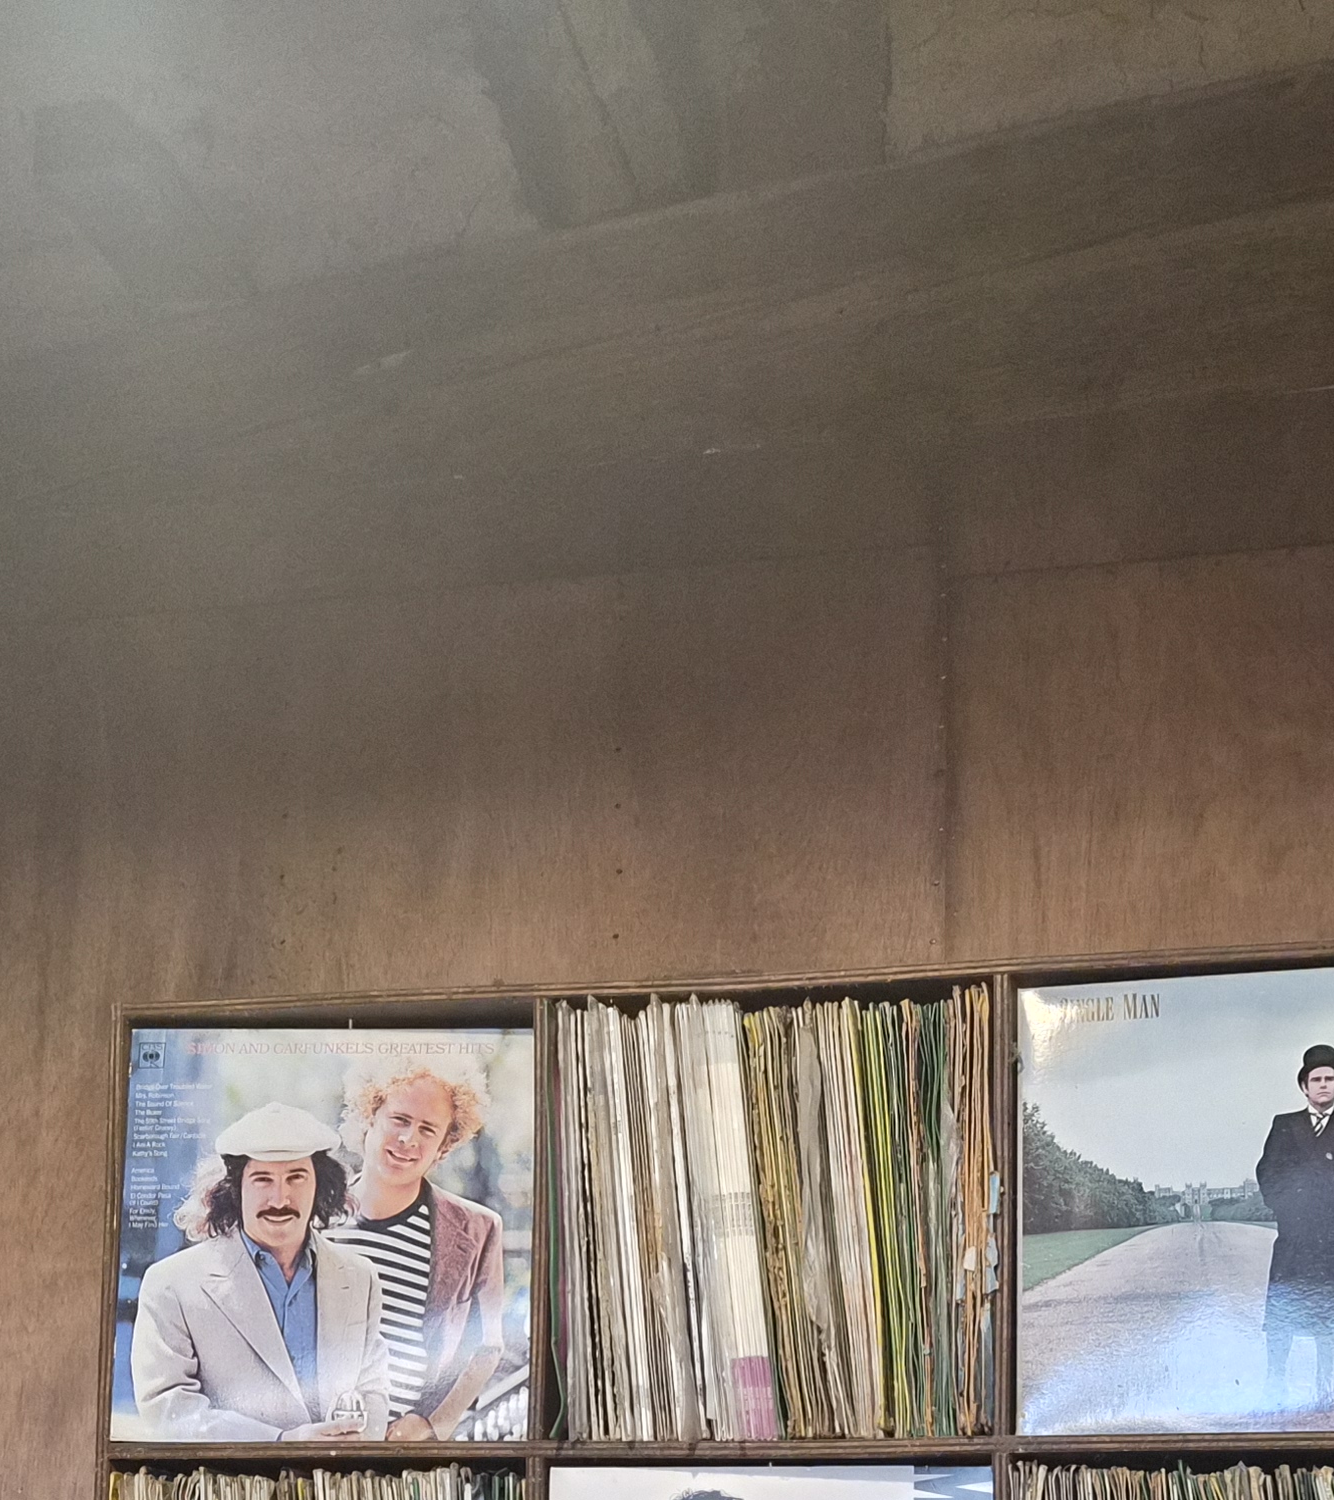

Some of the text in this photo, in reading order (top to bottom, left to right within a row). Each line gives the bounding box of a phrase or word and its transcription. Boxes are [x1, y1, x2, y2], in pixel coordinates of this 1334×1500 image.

[1123, 992, 1160, 1020] MAN
[187, 1042, 236, 1056] SIMON
[238, 1042, 271, 1056] AND
[377, 1042, 456, 1056] GREATEST
[458, 1042, 496, 1056] HITS
